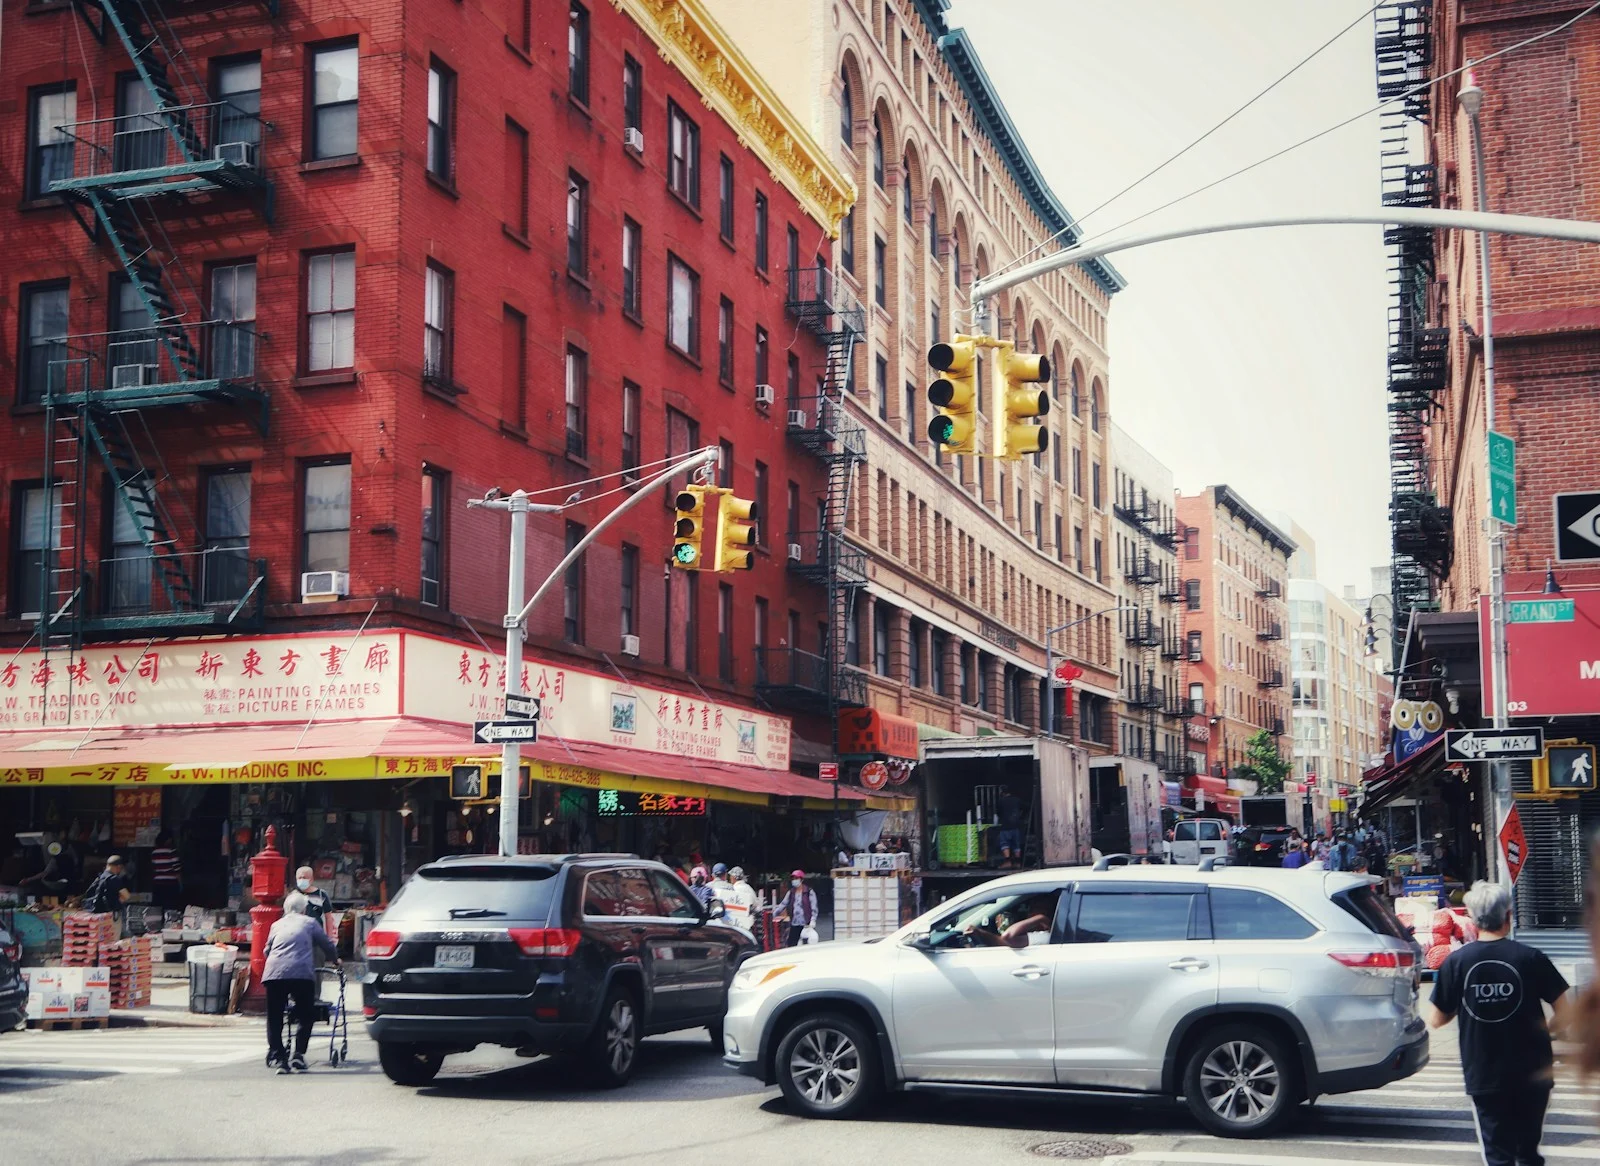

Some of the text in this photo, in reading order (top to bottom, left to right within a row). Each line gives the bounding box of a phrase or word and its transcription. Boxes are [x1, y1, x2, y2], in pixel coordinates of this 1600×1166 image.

[1511, 602, 1573, 621] GRAND ST
[238, 685, 311, 699] PAINTING
[320, 682, 380, 697] FRAMES
[29, 693, 100, 709] TRADING
[238, 700, 298, 713] PICTURE
[306, 697, 365, 711] FRAMES
[509, 701, 520, 711] ONE
[524, 703, 536, 713] WAY
[24, 710, 67, 722] GRAND
[484, 728, 529, 737] ONE WAY
[1461, 738, 1529, 751] ONE WAY
[221, 763, 289, 779] TRADING
[297, 761, 328, 777] INC.
[1470, 982, 1514, 998] TOTO
